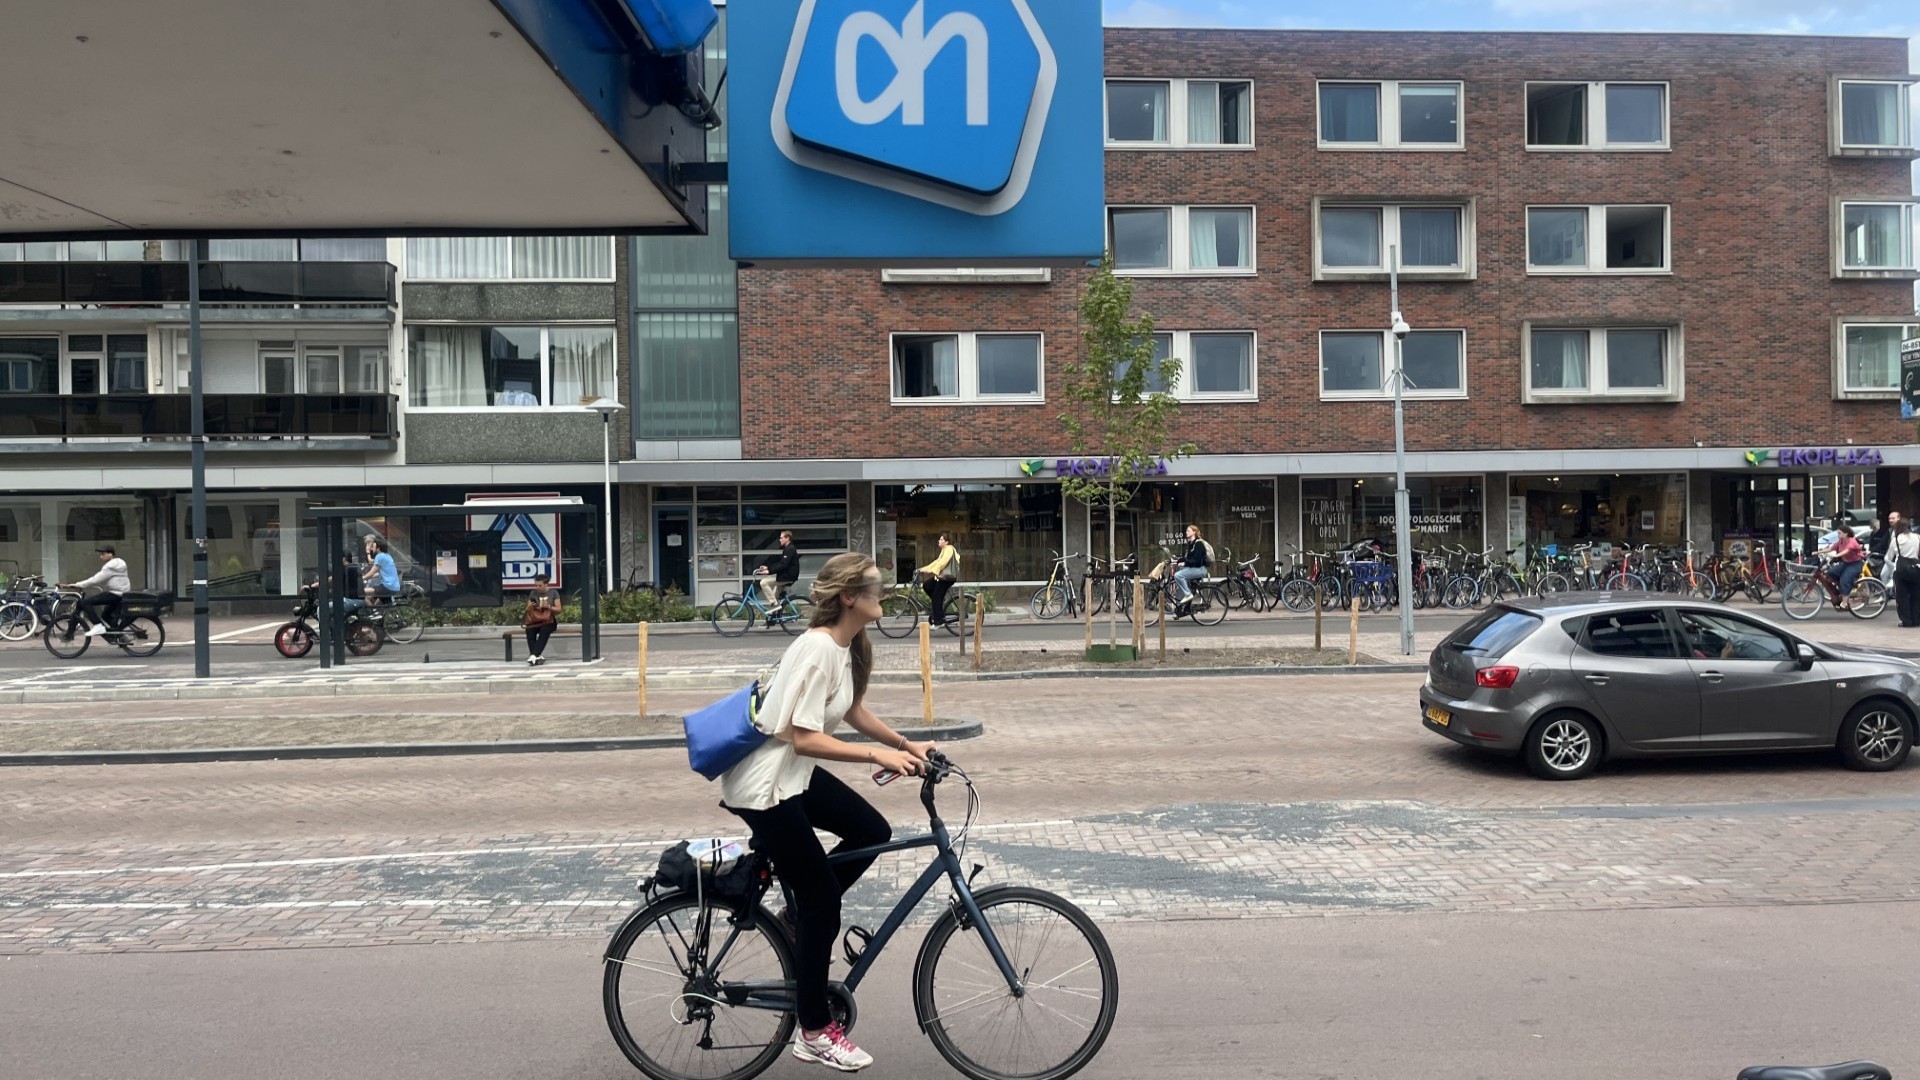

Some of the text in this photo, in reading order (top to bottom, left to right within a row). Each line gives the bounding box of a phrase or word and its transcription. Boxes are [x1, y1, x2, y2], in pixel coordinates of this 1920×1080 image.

[1779, 448, 1884, 466] EKOPLAZA
[1312, 500, 1345, 512] 7 DAGEN
[1310, 512, 1346, 525] PER WEEK
[1379, 514, 1462, 524] 100 OLOGISCHE
[1319, 527, 1337, 538] OPEN
[502, 562, 545, 579] LDI
